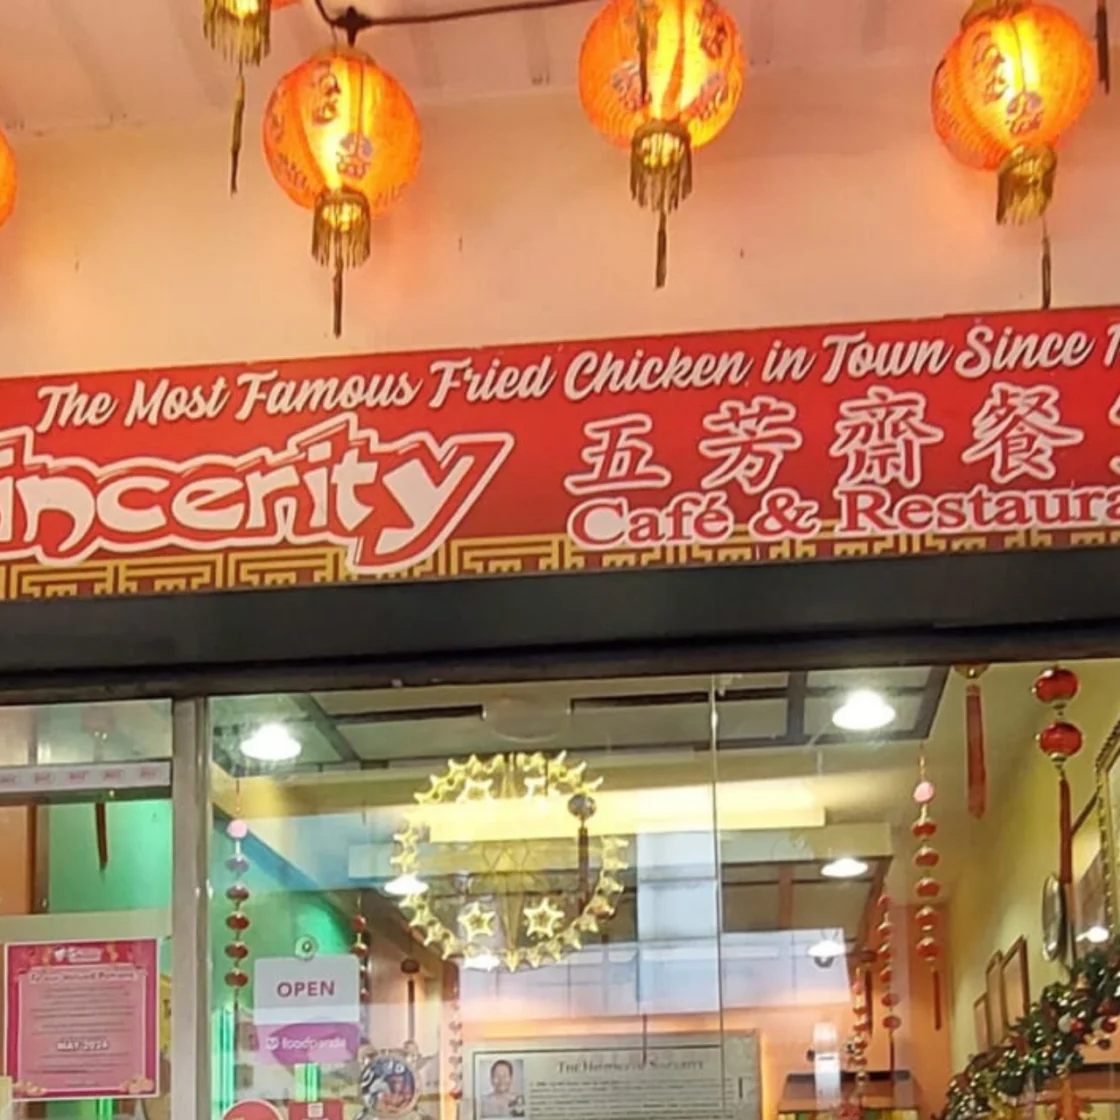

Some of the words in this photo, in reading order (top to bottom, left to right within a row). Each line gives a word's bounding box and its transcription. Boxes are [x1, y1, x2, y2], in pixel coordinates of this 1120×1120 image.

[36, 383, 117, 433] The
[124, 377, 230, 427] Most
[235, 368, 423, 421] Famous
[431, 355, 557, 411] Fried
[564, 342, 756, 399] Chicken
[761, 338, 817, 384] in
[820, 331, 952, 386] Town
[954, 325, 1096, 380] Since
[564, 383, 1120, 494] 五芳齋餐
[567, 491, 734, 549] Café
[751, 491, 820, 540] &
[276, 981, 336, 998] OPEN
